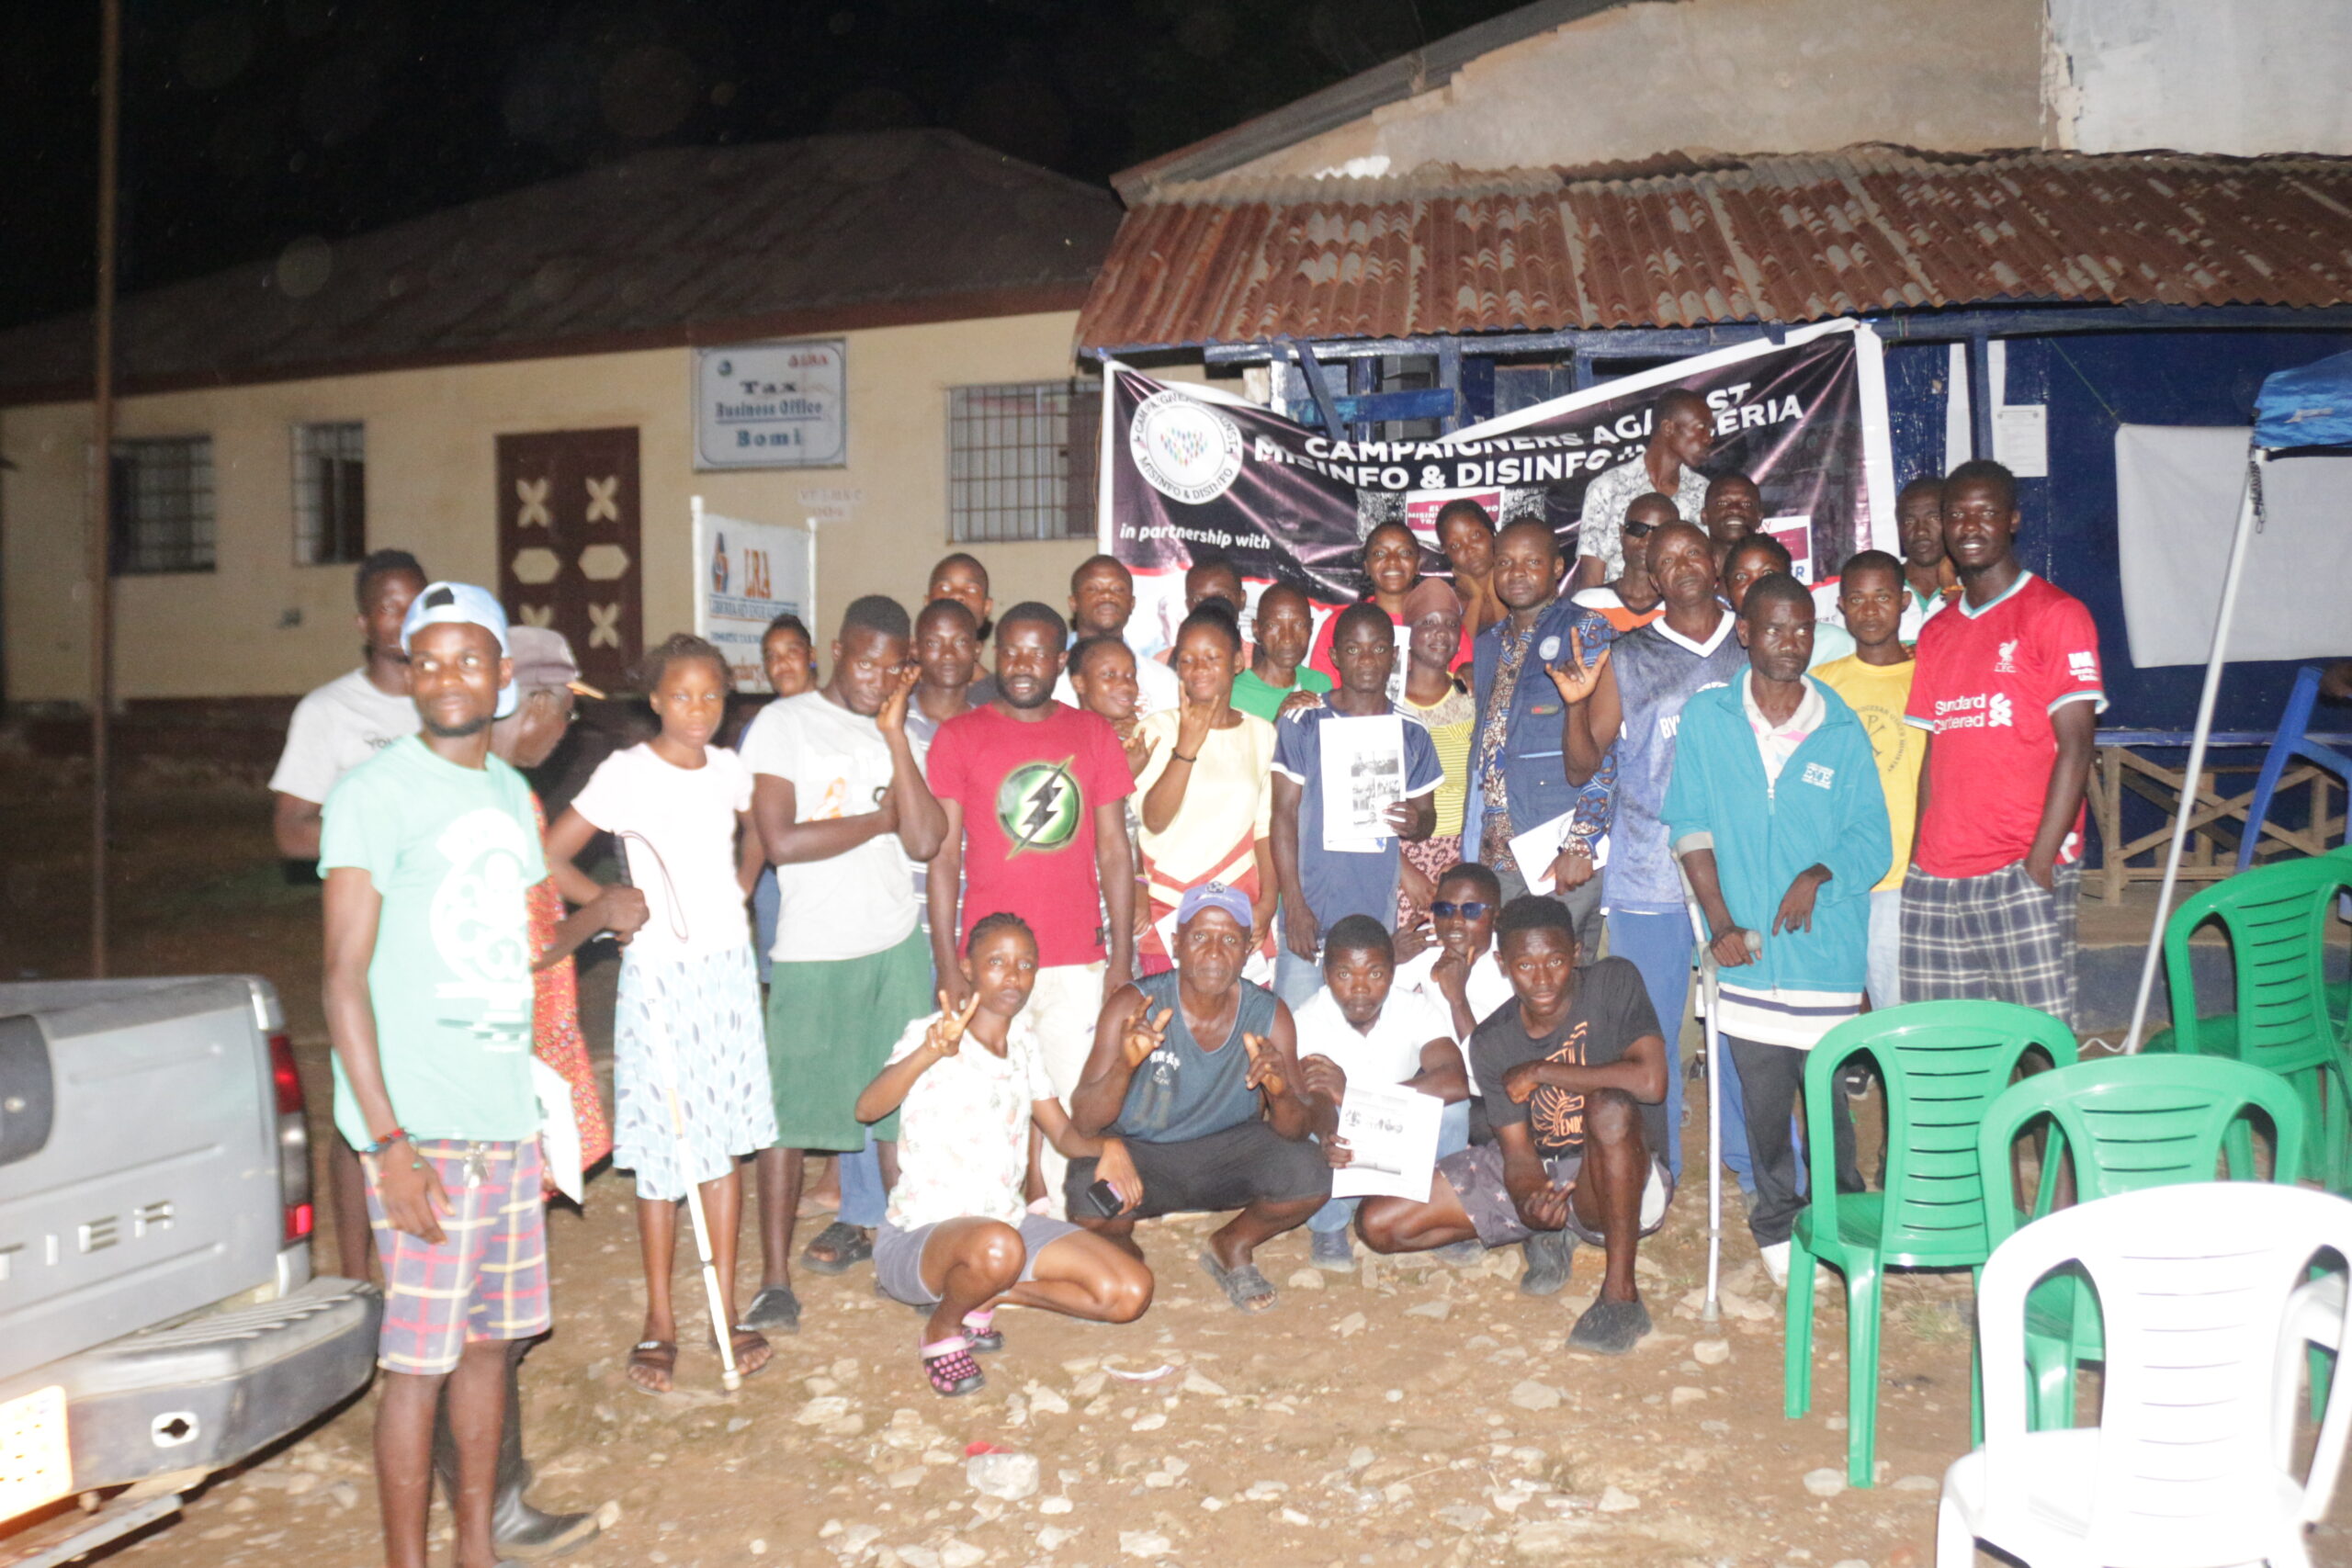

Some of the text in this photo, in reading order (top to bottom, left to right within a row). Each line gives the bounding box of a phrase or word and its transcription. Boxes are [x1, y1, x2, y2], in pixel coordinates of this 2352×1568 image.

[740, 380, 797, 394] Tax
[716, 398, 823, 417] Business Office
[1305, 382, 1751, 462] CAMPAIGNERS AGST
[737, 428, 802, 447] Bomi
[1255, 434, 1409, 491] MISINFO
[1420, 465, 1447, 490] &
[1457, 448, 1612, 487] DISINFO
[1709, 394, 1804, 437] ERIA
[1119, 523, 1271, 550] in partnership with
[743, 547, 773, 600] LRA
